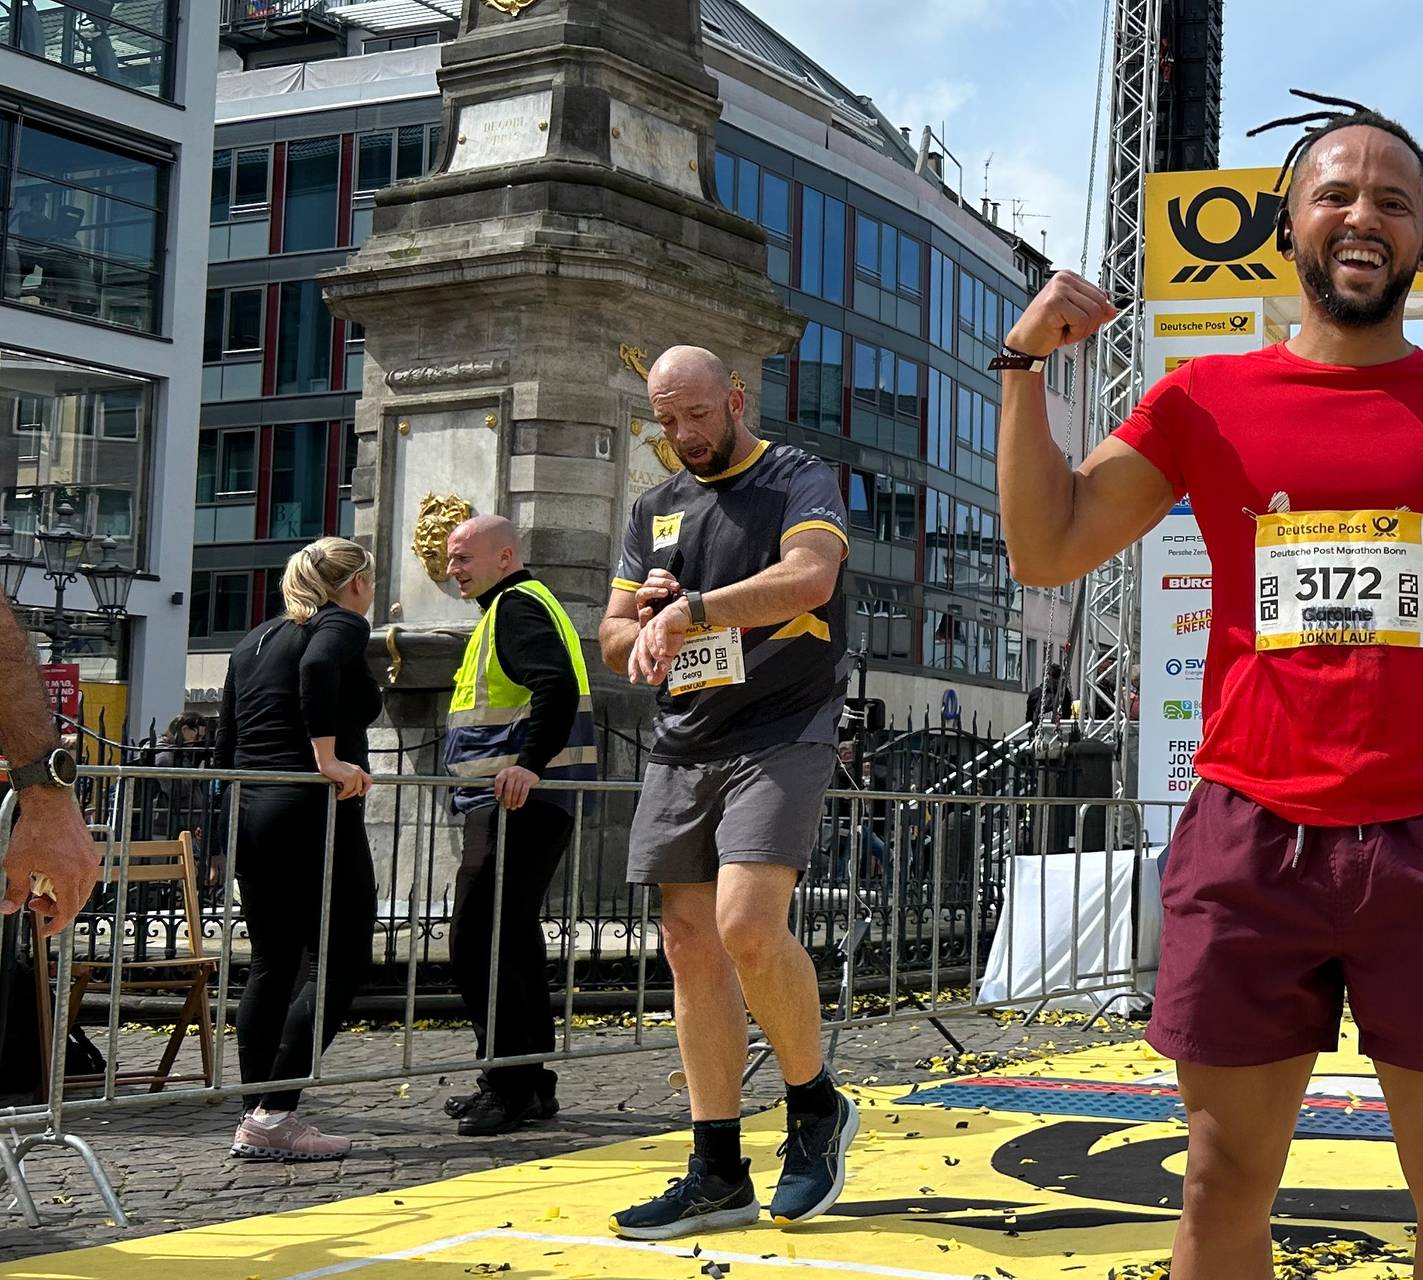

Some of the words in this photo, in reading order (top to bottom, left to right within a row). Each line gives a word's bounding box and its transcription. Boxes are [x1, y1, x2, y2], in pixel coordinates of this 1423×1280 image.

[1160, 321, 1203, 331] Deutsche
[1205, 320, 1226, 330] Post
[1277, 523, 1335, 537] Deutsche
[1338, 522, 1367, 534] Post
[1270, 548, 1312, 559] Deutsche
[1313, 547, 1335, 555] Post
[1336, 546, 1382, 555] Marathon
[1383, 547, 1407, 556] Bonn
[1169, 576, 1212, 588] BÜRG
[1295, 567, 1382, 601] 3172
[1176, 608, 1212, 624] DEXTR
[1176, 619, 1212, 635] ENERG
[1299, 632, 1337, 644] 10KM
[1339, 631, 1377, 644] LAUF
[673, 647, 712, 672] 2330
[682, 670, 702, 681] Georg
[1168, 753, 1195, 765] JOY
[1168, 767, 1200, 779] JOIE
